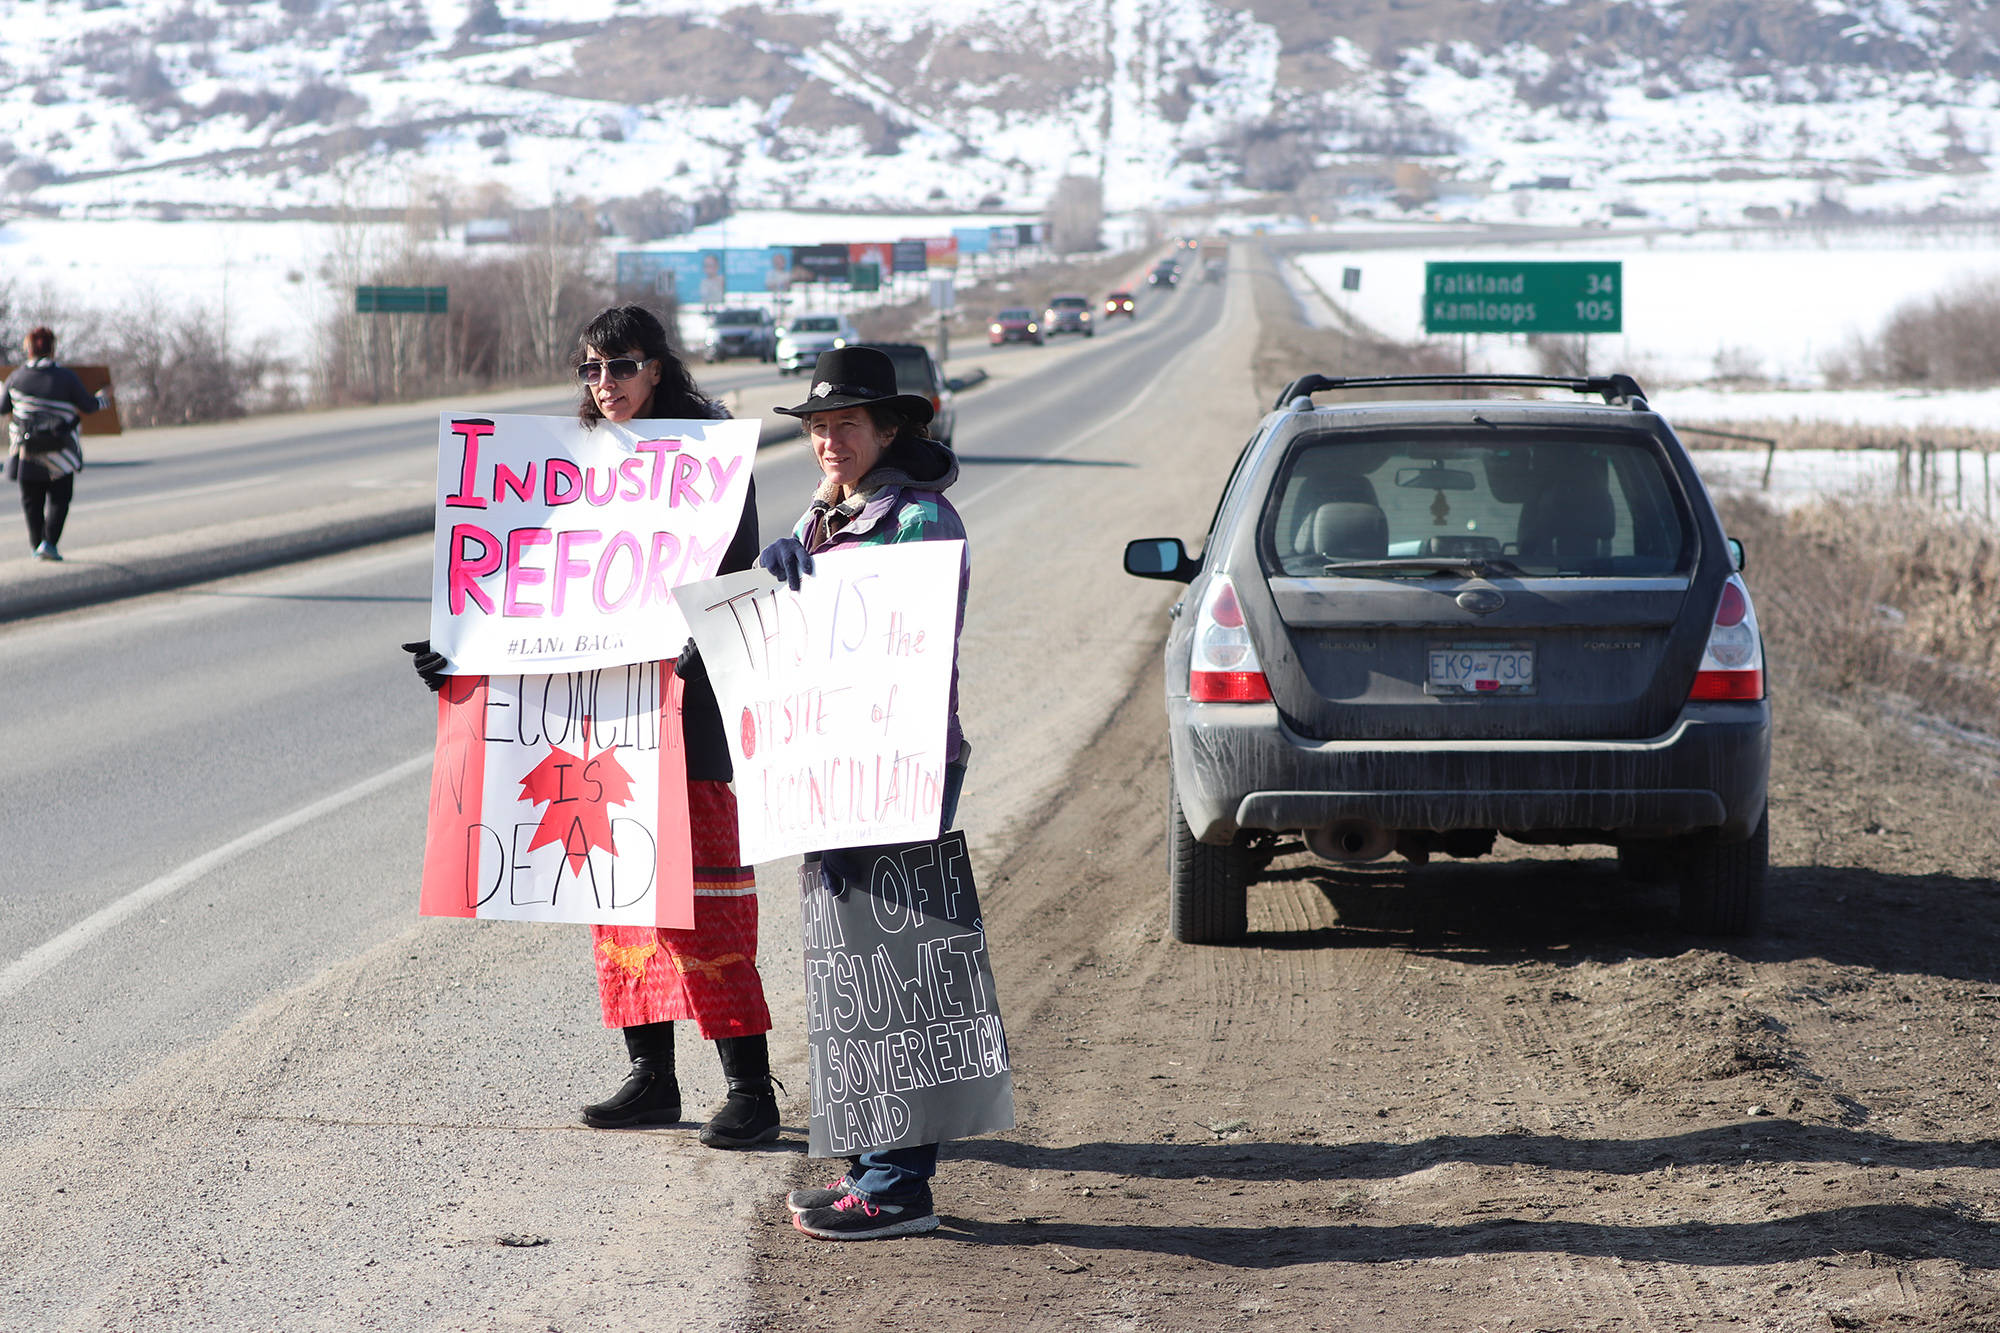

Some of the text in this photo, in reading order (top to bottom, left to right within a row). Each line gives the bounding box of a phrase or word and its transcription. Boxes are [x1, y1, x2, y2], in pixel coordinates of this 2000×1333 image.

[1433, 273, 1614, 294] Falkland 34
[1433, 301, 1615, 325] Kamloops 105
[445, 418, 743, 510] INDUSTRY
[447, 522, 730, 618] REFORM
[883, 611, 927, 656] the
[1430, 654, 1473, 680] EK9
[870, 682, 899, 737] of
[552, 760, 604, 806] IS
[465, 814, 657, 910] DEAD
[870, 837, 964, 935] OFF
[826, 1093, 911, 1153] LAND
